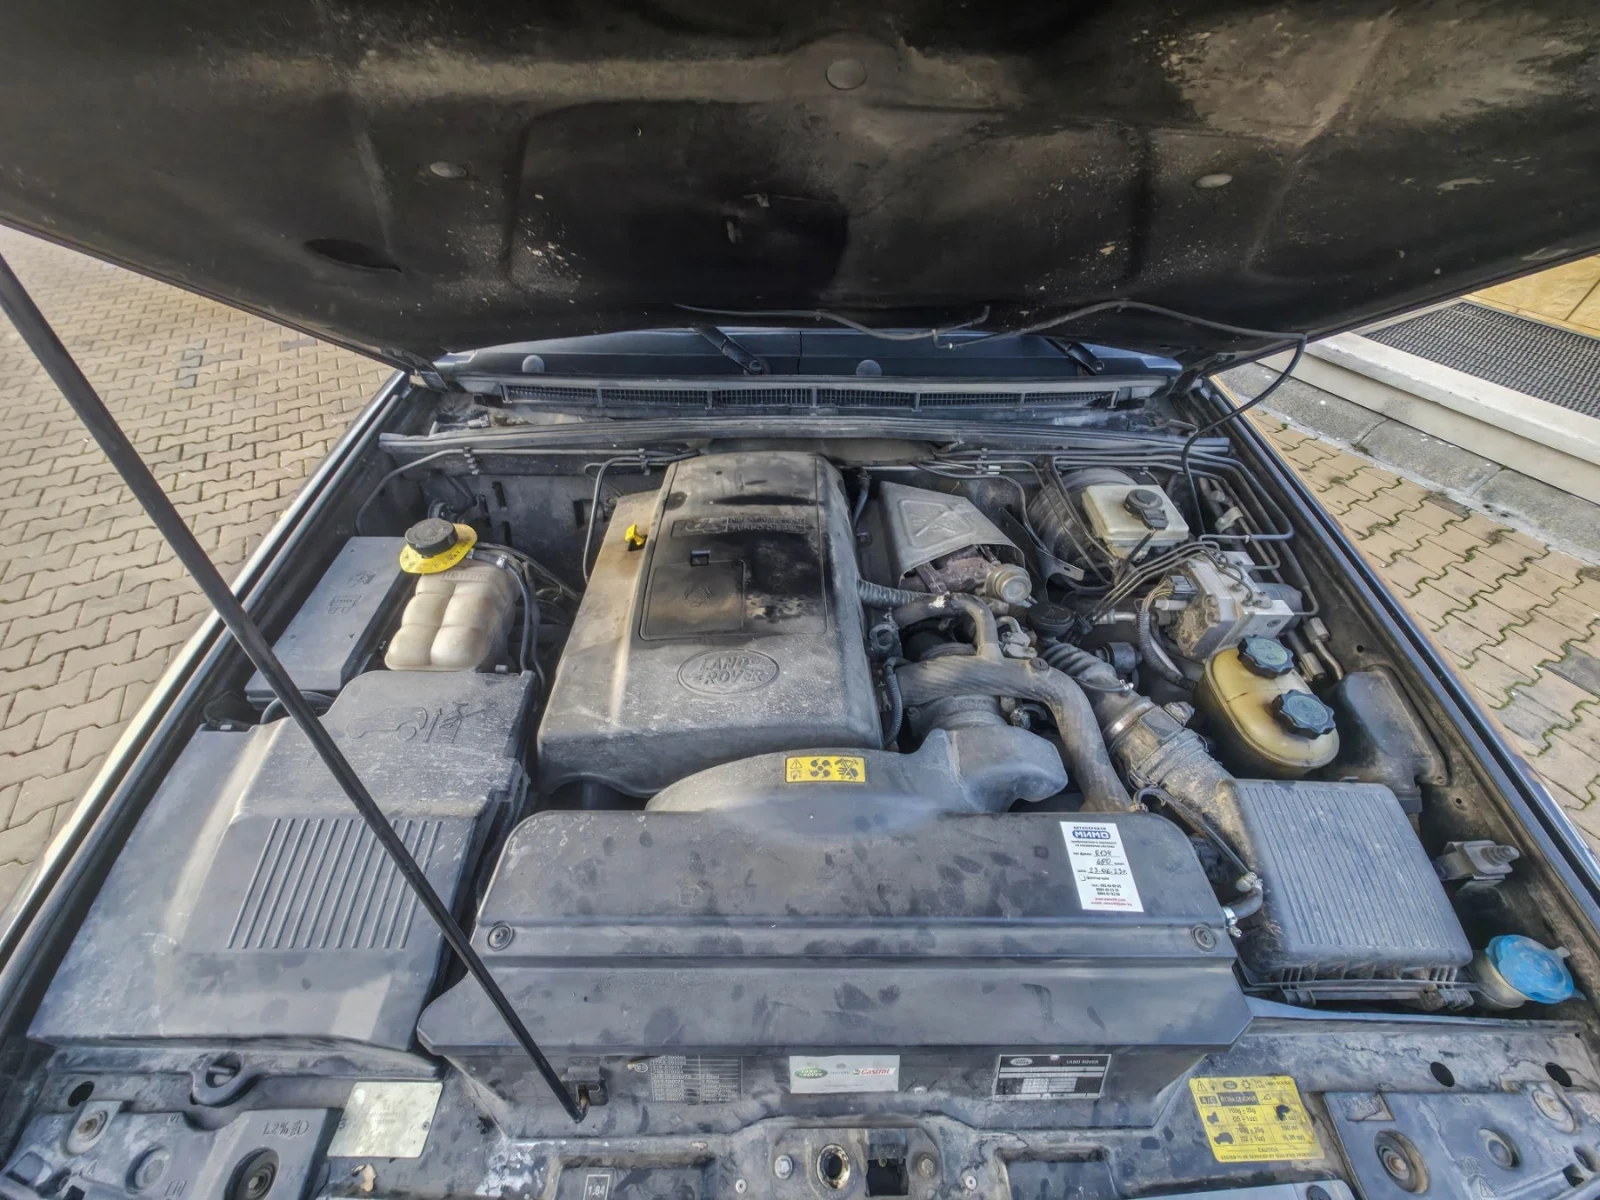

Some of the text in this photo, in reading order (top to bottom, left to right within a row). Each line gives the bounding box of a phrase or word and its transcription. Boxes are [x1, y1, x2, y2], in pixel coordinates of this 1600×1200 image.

[700, 657, 750, 670] LAND
[703, 670, 764, 685] ROVER
[588, 1185, 606, 1196] 1.84
